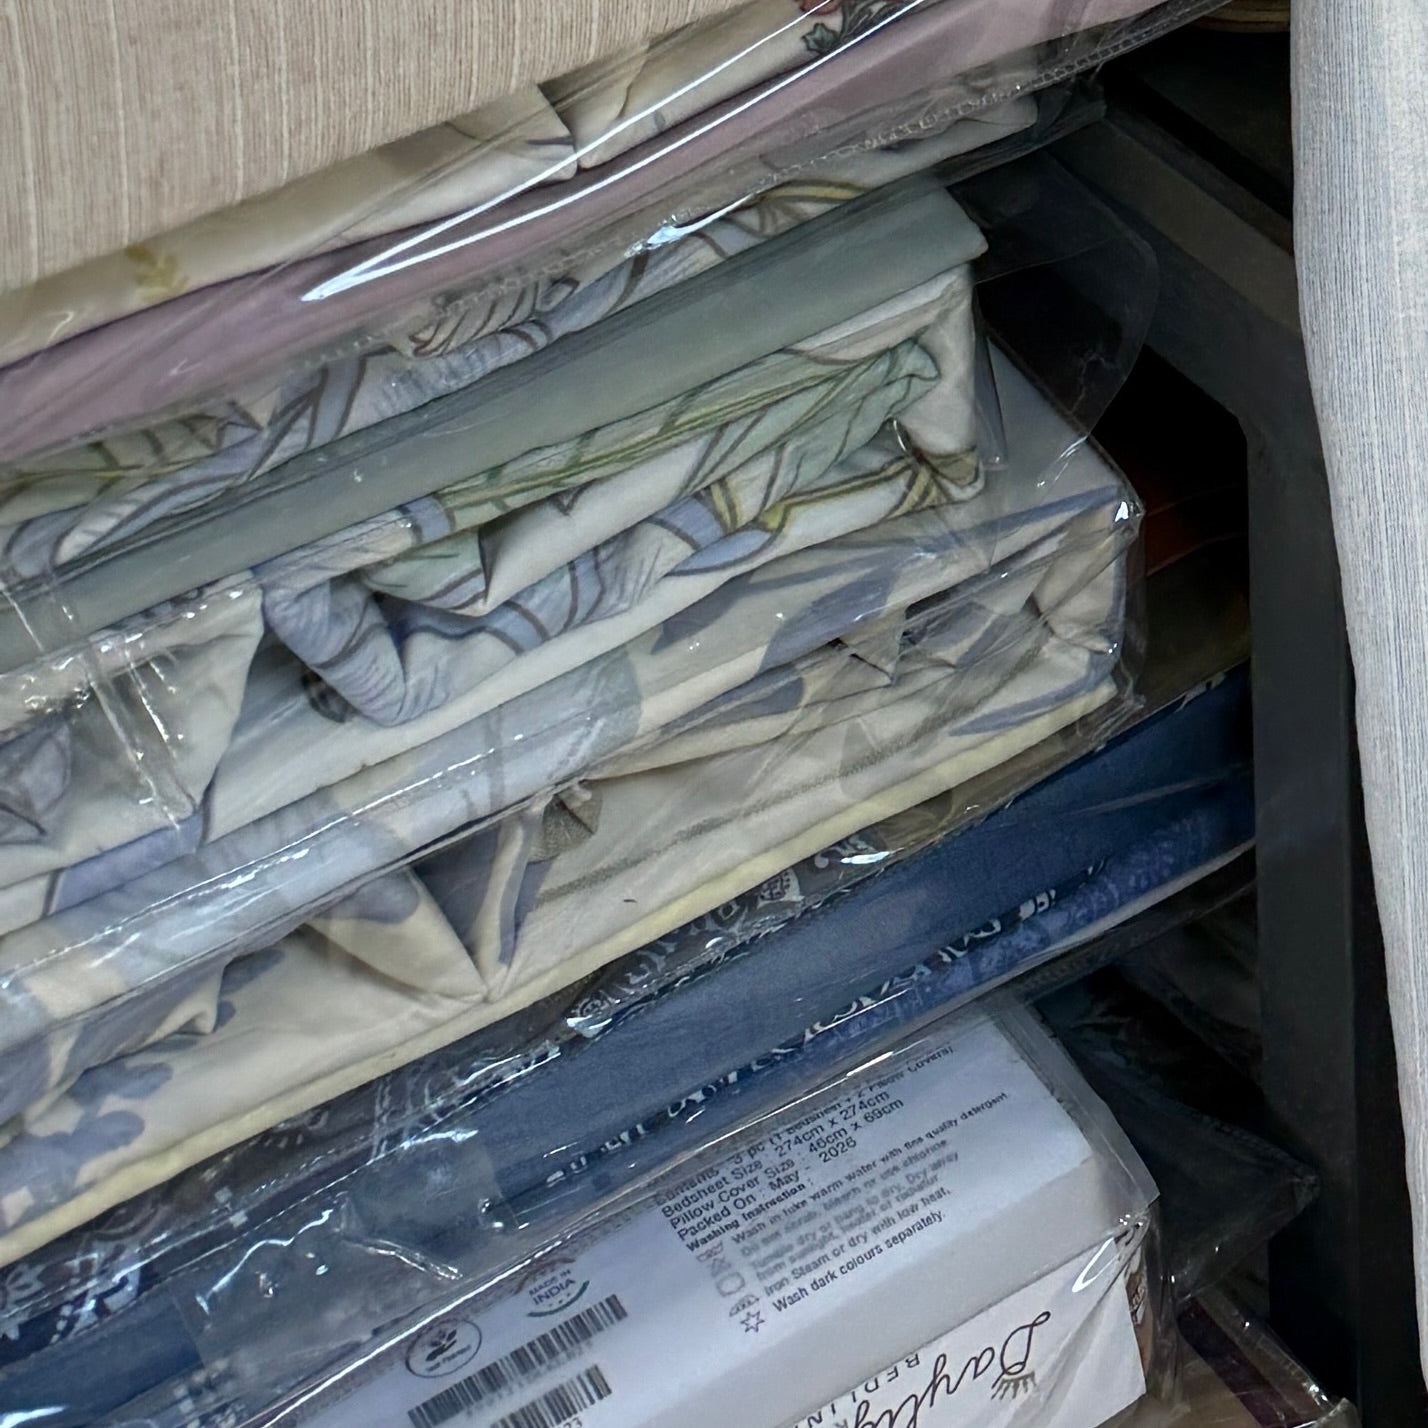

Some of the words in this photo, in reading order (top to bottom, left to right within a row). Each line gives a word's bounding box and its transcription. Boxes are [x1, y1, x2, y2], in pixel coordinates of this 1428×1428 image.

[660, 1173, 731, 1219] Bedsheet
[730, 1156, 764, 1183] Size
[772, 1121, 827, 1159] 274cm
[826, 1116, 840, 1129] x
[838, 1087, 891, 1124] 274cm
[667, 1196, 717, 1231] Pillow
[716, 1173, 761, 1205] Cover
[762, 1155, 796, 1181] Size
[805, 1124, 849, 1156] 46cm
[850, 1119, 863, 1132] x
[861, 1095, 905, 1126] 69cm
[675, 1204, 732, 1243] Packed
[731, 1189, 758, 1212] On
[767, 1167, 803, 1195] May
[817, 1134, 859, 1165] 2026
[730, 1219, 768, 1246] Wash
[767, 1212, 782, 1226] in
[781, 1196, 810, 1218] luke
[809, 1179, 844, 1203] warm
[843, 1158, 879, 1184] water
[878, 1145, 903, 1164] with
[923, 1115, 961, 1143] quality
[527, 1275, 558, 1296] MADE
[558, 1268, 571, 1278] IN
[685, 1216, 741, 1253] Washing
[761, 1273, 791, 1297] Iron
[789, 1250, 831, 1281] Steam
[829, 1241, 847, 1258] or
[845, 1227, 872, 1252] dry
[868, 1212, 898, 1236] with
[894, 1199, 922, 1222] low
[770, 1283, 810, 1313] Wash
[806, 1266, 839, 1292] dark
[835, 1240, 885, 1276] colours
[531, 1275, 577, 1306] INDIA
